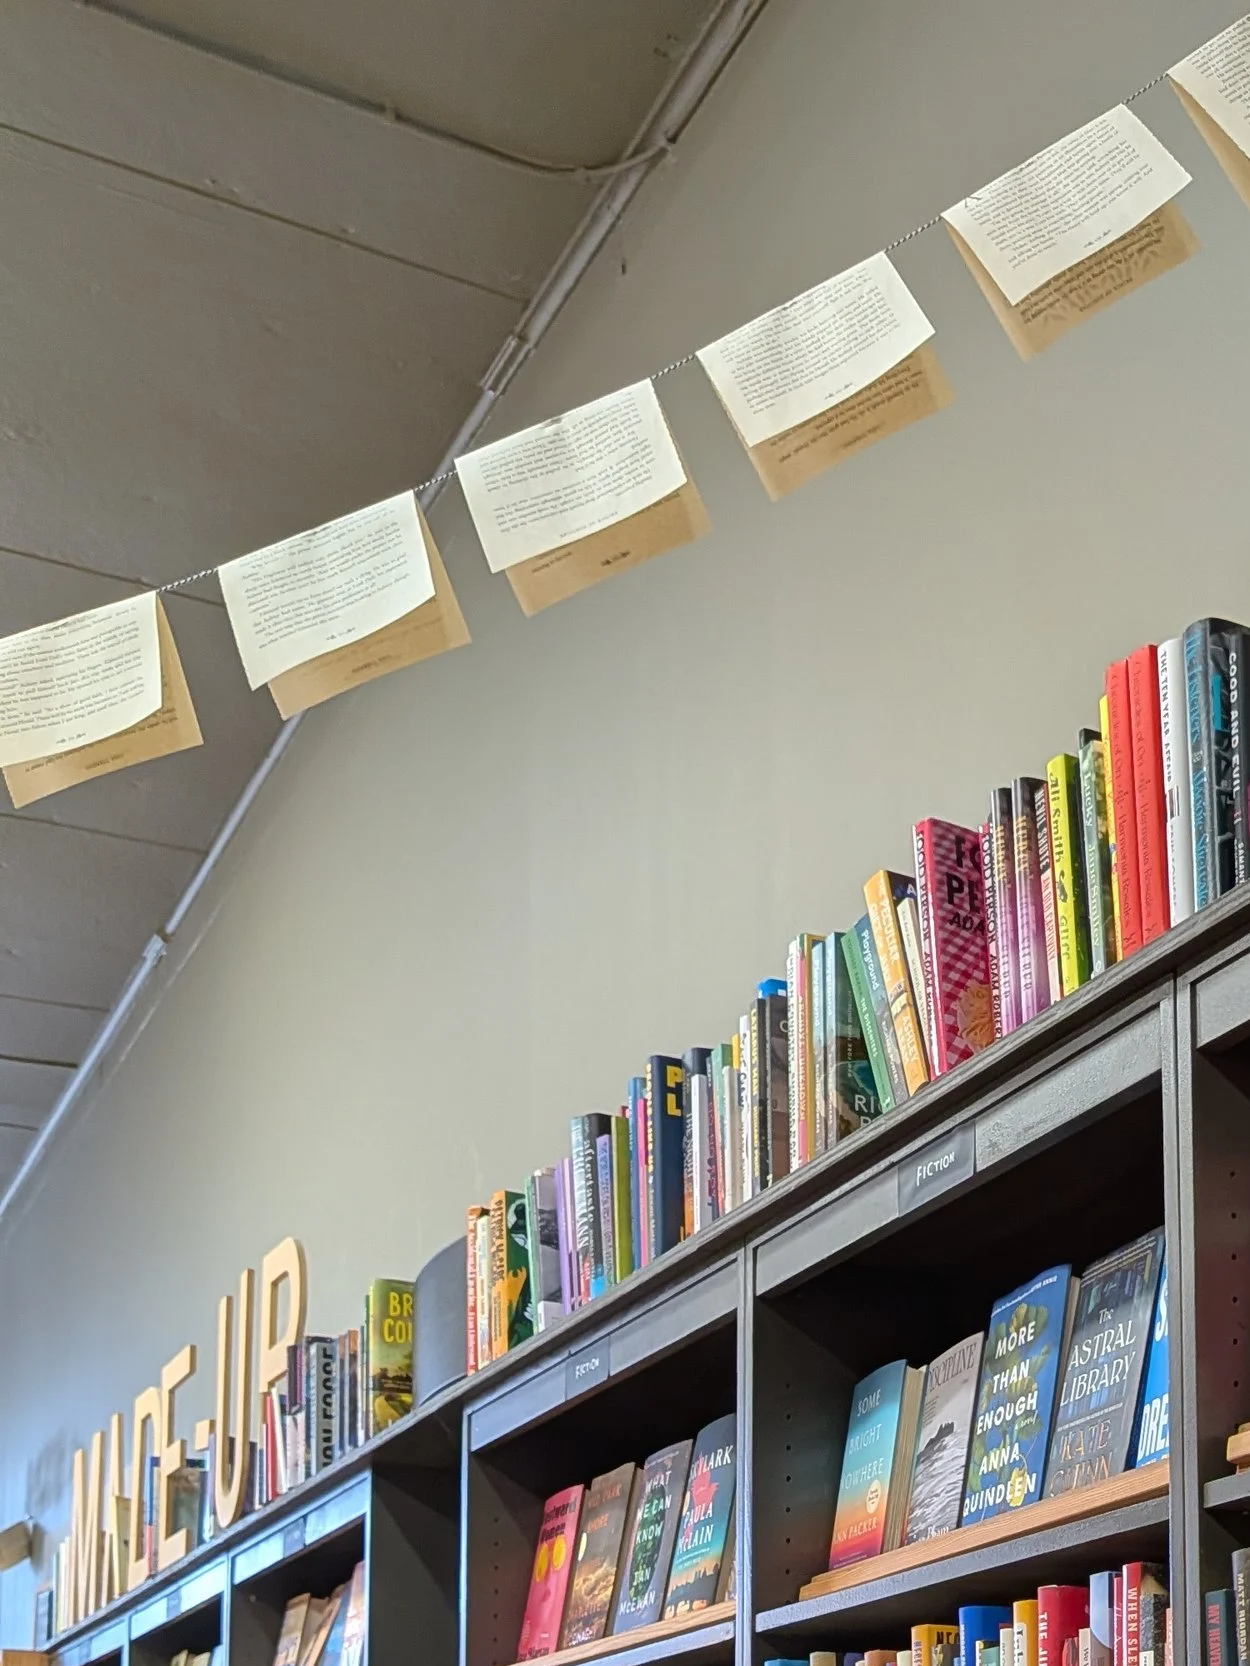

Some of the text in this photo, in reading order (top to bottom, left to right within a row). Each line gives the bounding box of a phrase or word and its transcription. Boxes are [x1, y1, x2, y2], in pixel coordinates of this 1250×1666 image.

[916, 1150, 955, 1186] FICTION
[995, 1322, 1035, 1360] MORE
[1068, 1321, 1137, 1370] ASTRAL
[575, 1358, 600, 1379] FICTION
[992, 1360, 1030, 1394] THAN
[1060, 1352, 1137, 1406] LIBRARY
[977, 1391, 1037, 1436] ENOUGH
[979, 1443, 1020, 1476] ANNA
[963, 1474, 1035, 1517] QUINDLEN
